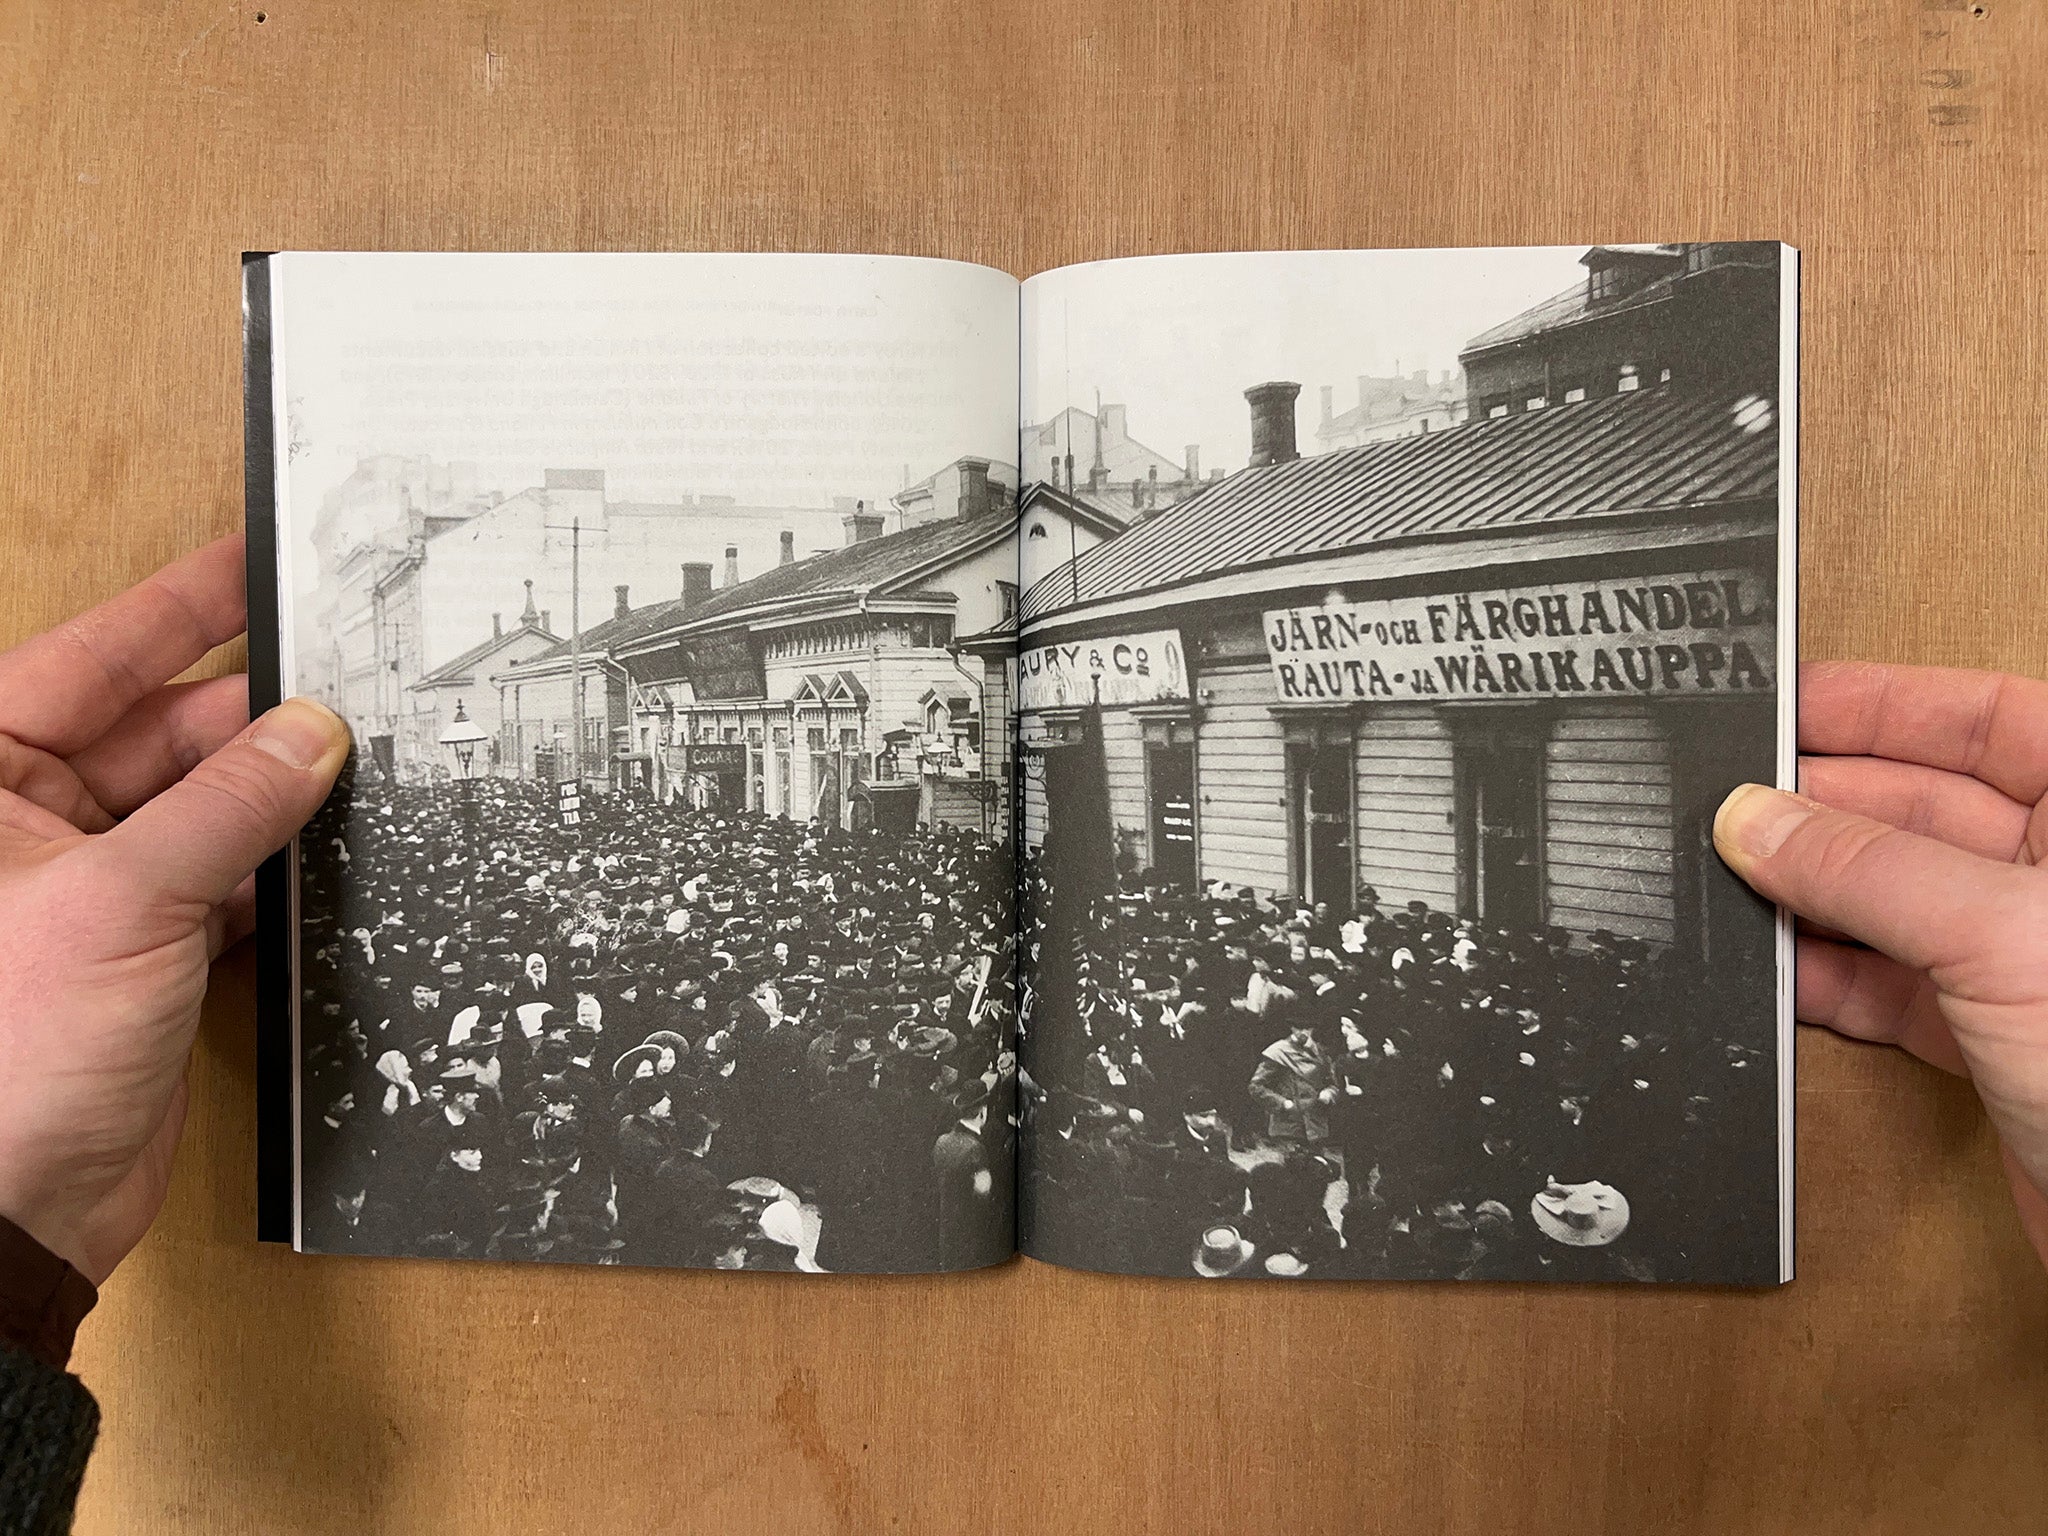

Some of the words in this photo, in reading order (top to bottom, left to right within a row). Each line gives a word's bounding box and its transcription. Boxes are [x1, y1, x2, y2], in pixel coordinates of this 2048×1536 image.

[1426, 579, 1766, 643] FÄRGHANDEL
[1089, 648, 1106, 671] &
[1434, 641, 1769, 693] WÄRIKAUPPA
